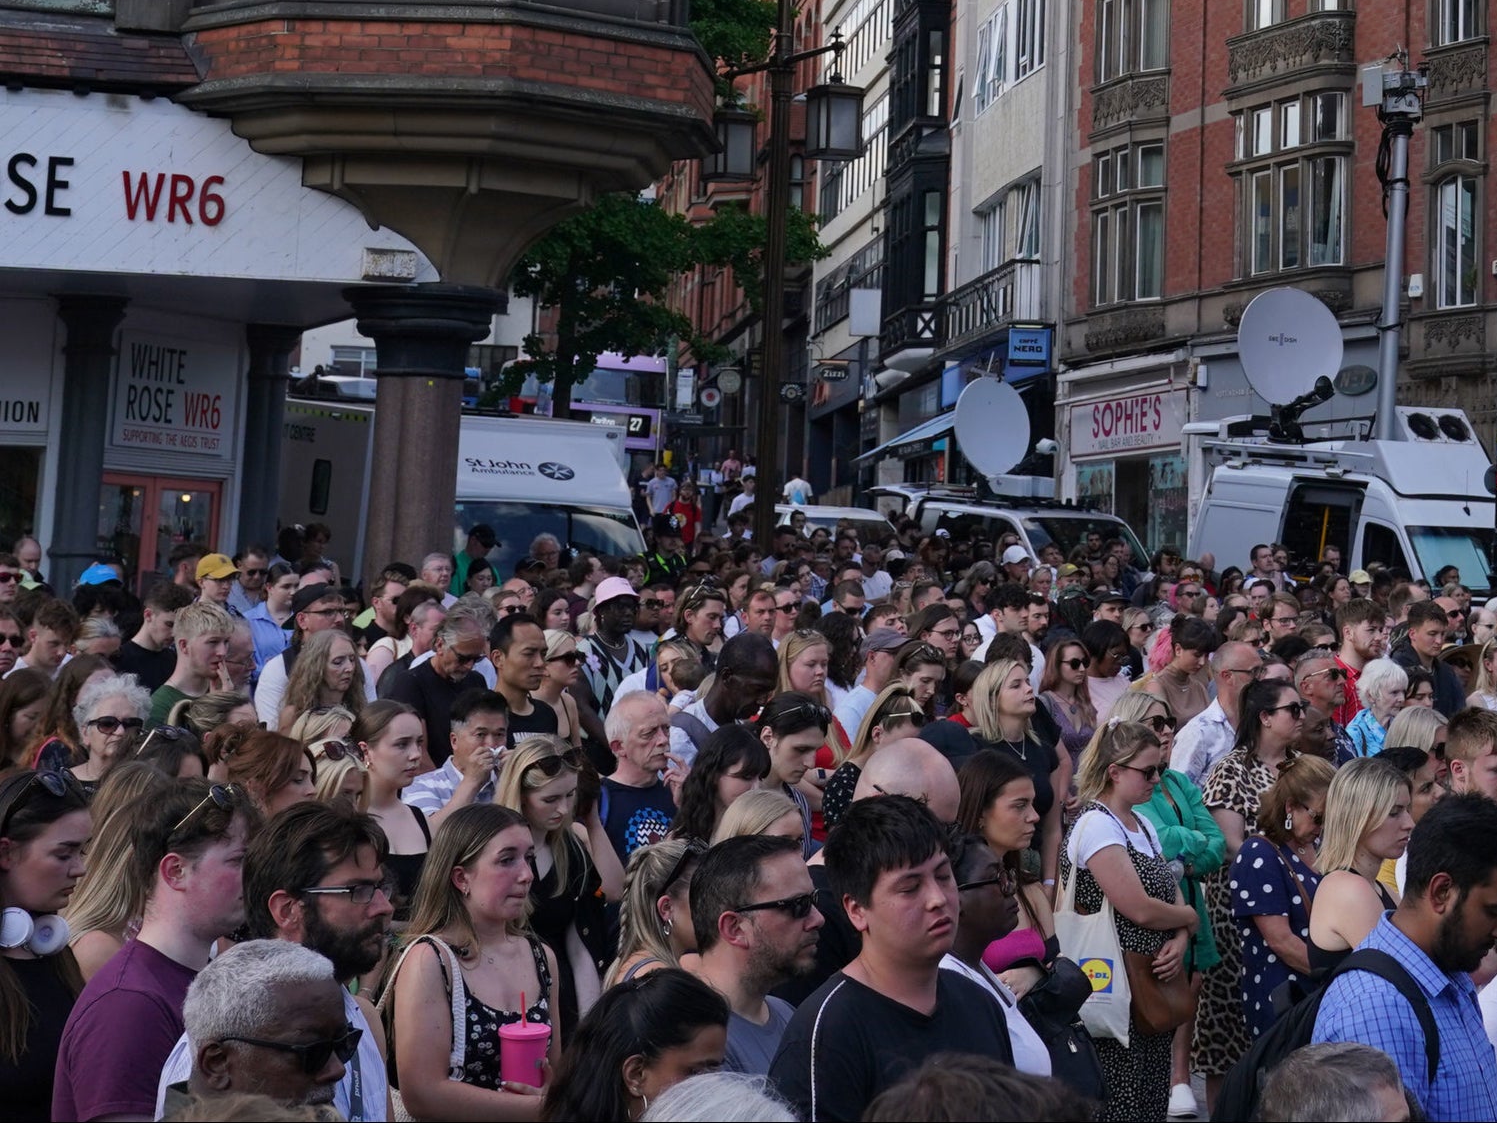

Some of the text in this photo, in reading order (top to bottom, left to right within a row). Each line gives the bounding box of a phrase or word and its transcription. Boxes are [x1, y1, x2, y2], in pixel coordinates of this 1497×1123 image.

[122, 170, 226, 227] WR6
[1013, 345, 1043, 353] NERO
[131, 342, 187, 385] WHITE
[823, 369, 845, 378] Zizzi
[126, 385, 222, 430] ROSE WR6
[629, 417, 643, 432] 27
[123, 429, 221, 451] SUPPORTING THE AEGIS TRUST
[465, 457, 532, 470] St John
[471, 466, 536, 476] Ambulance
